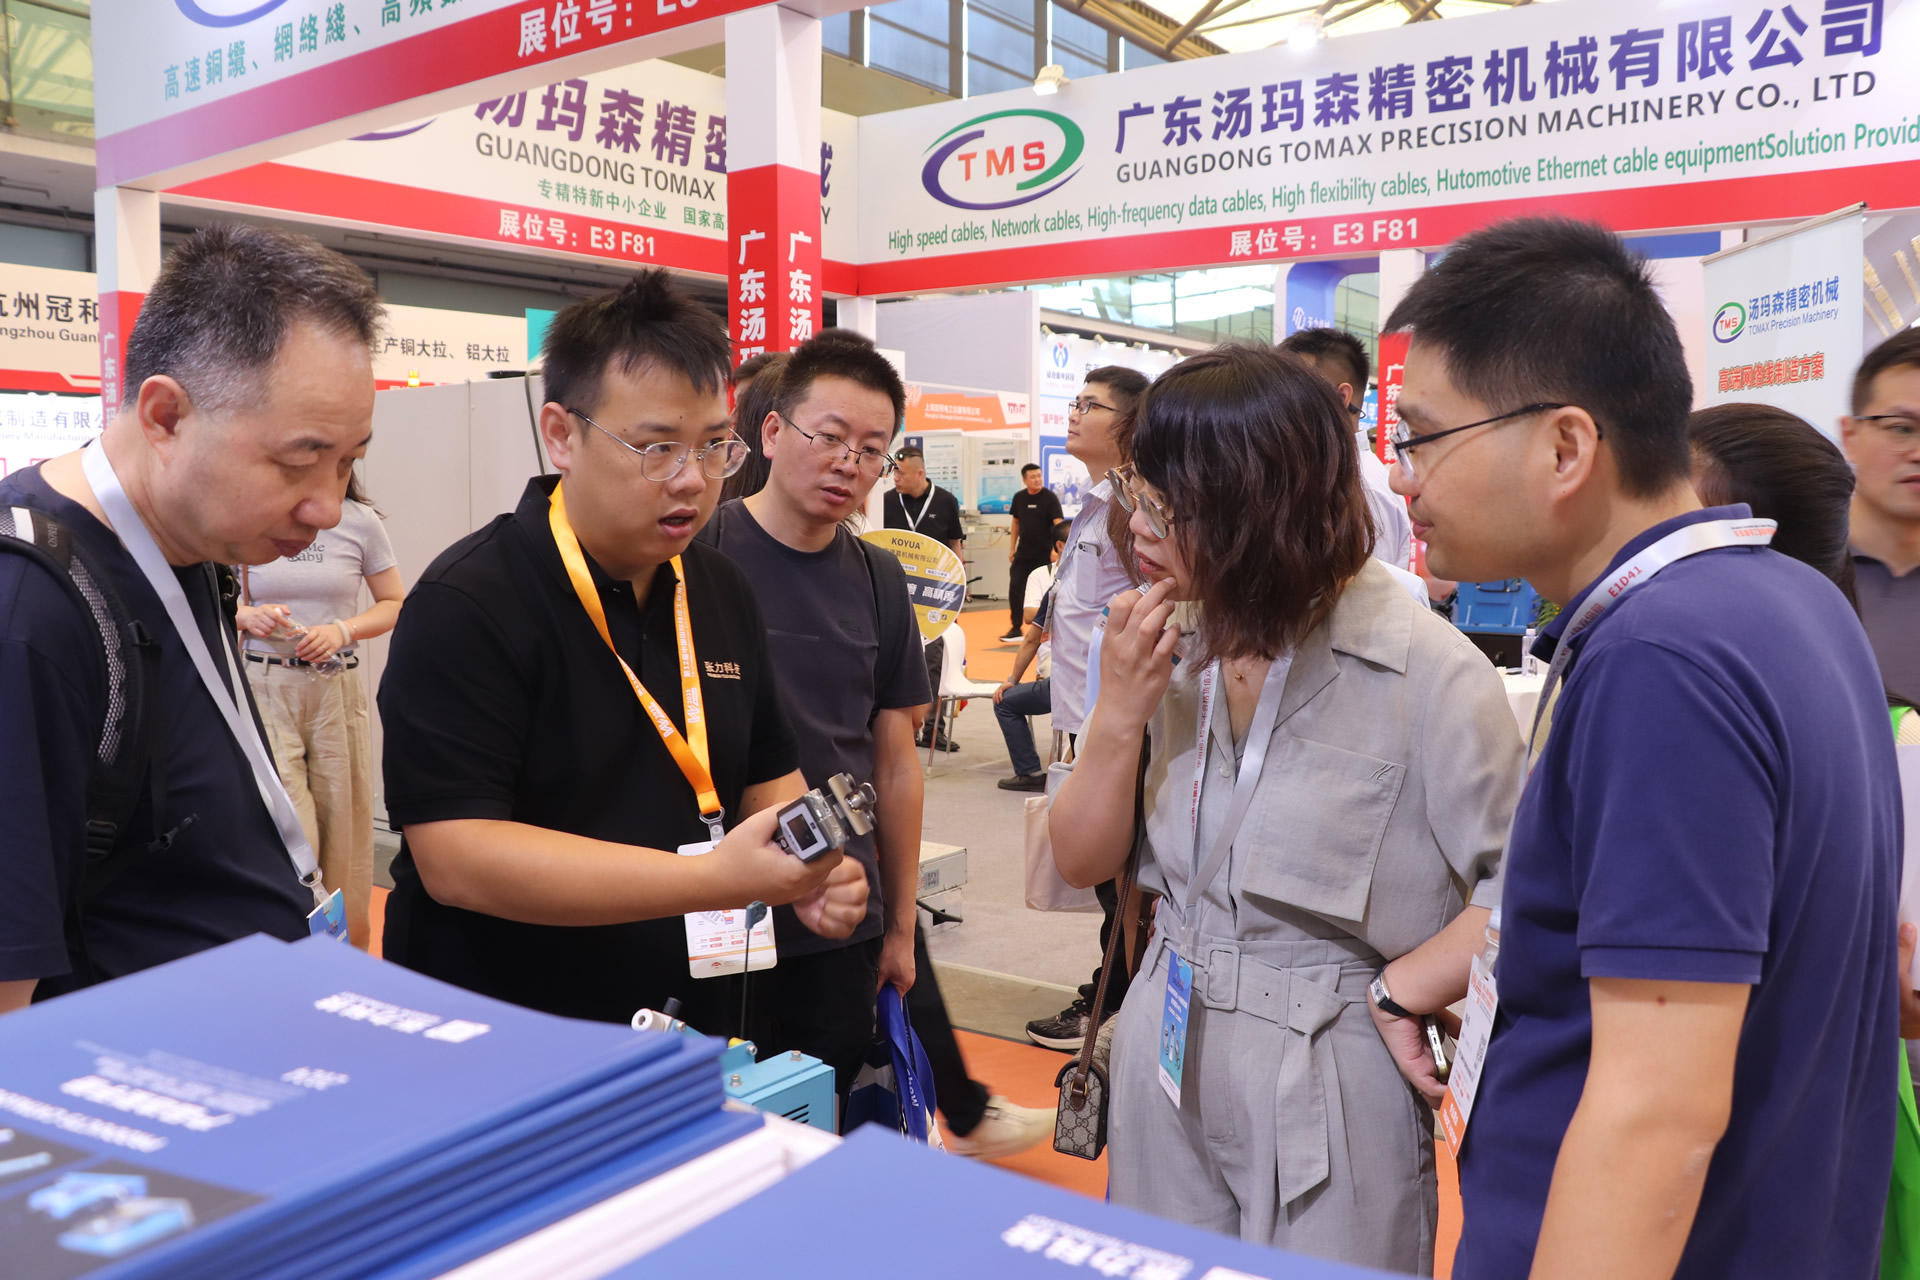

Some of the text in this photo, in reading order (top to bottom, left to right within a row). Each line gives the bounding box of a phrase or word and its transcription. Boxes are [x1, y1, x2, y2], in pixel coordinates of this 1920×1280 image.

[1116, 0, 1884, 154] 广东汤玛森精密机械有限公司
[1117, 70, 1876, 183] GUANGDONG TOMAX PRECISION MACHINERY CO., LTD
[475, 132, 716, 201] GUANGDONG TOMAX
[958, 141, 1046, 181] TMS
[683, 206, 727, 232] 国家高
[888, 230, 913, 254] High
[916, 224, 948, 251] speed
[951, 221, 988, 242] cables,
[991, 213, 1041, 238] Network
[1044, 209, 1083, 232] cables,
[1087, 202, 1185, 232] High-frequency
[1189, 194, 1217, 217] data
[1222, 189, 1267, 213] cables,
[1272, 183, 1305, 213] High
[1310, 177, 1376, 205] flexibility
[1381, 171, 1431, 197] cables,
[1437, 159, 1531, 192] Hutomotive
[1537, 153, 1607, 182] Ethernet
[1613, 146, 1658, 176] cable
[498, 208, 656, 257] 展位号： E3 F81
[1229, 217, 1417, 257] 展位号： E3 F81
[788, 231, 812, 354] 广东汤
[1748, 275, 1839, 322] 汤玛森精密机械
[59, 330, 99, 343] Guan
[1719, 317, 1738, 331] TMS
[1748, 308, 1839, 335] TOMAX Precision Machinery
[891, 537, 921, 550] KOYUA
[1608, 565, 1643, 598] E1D41
